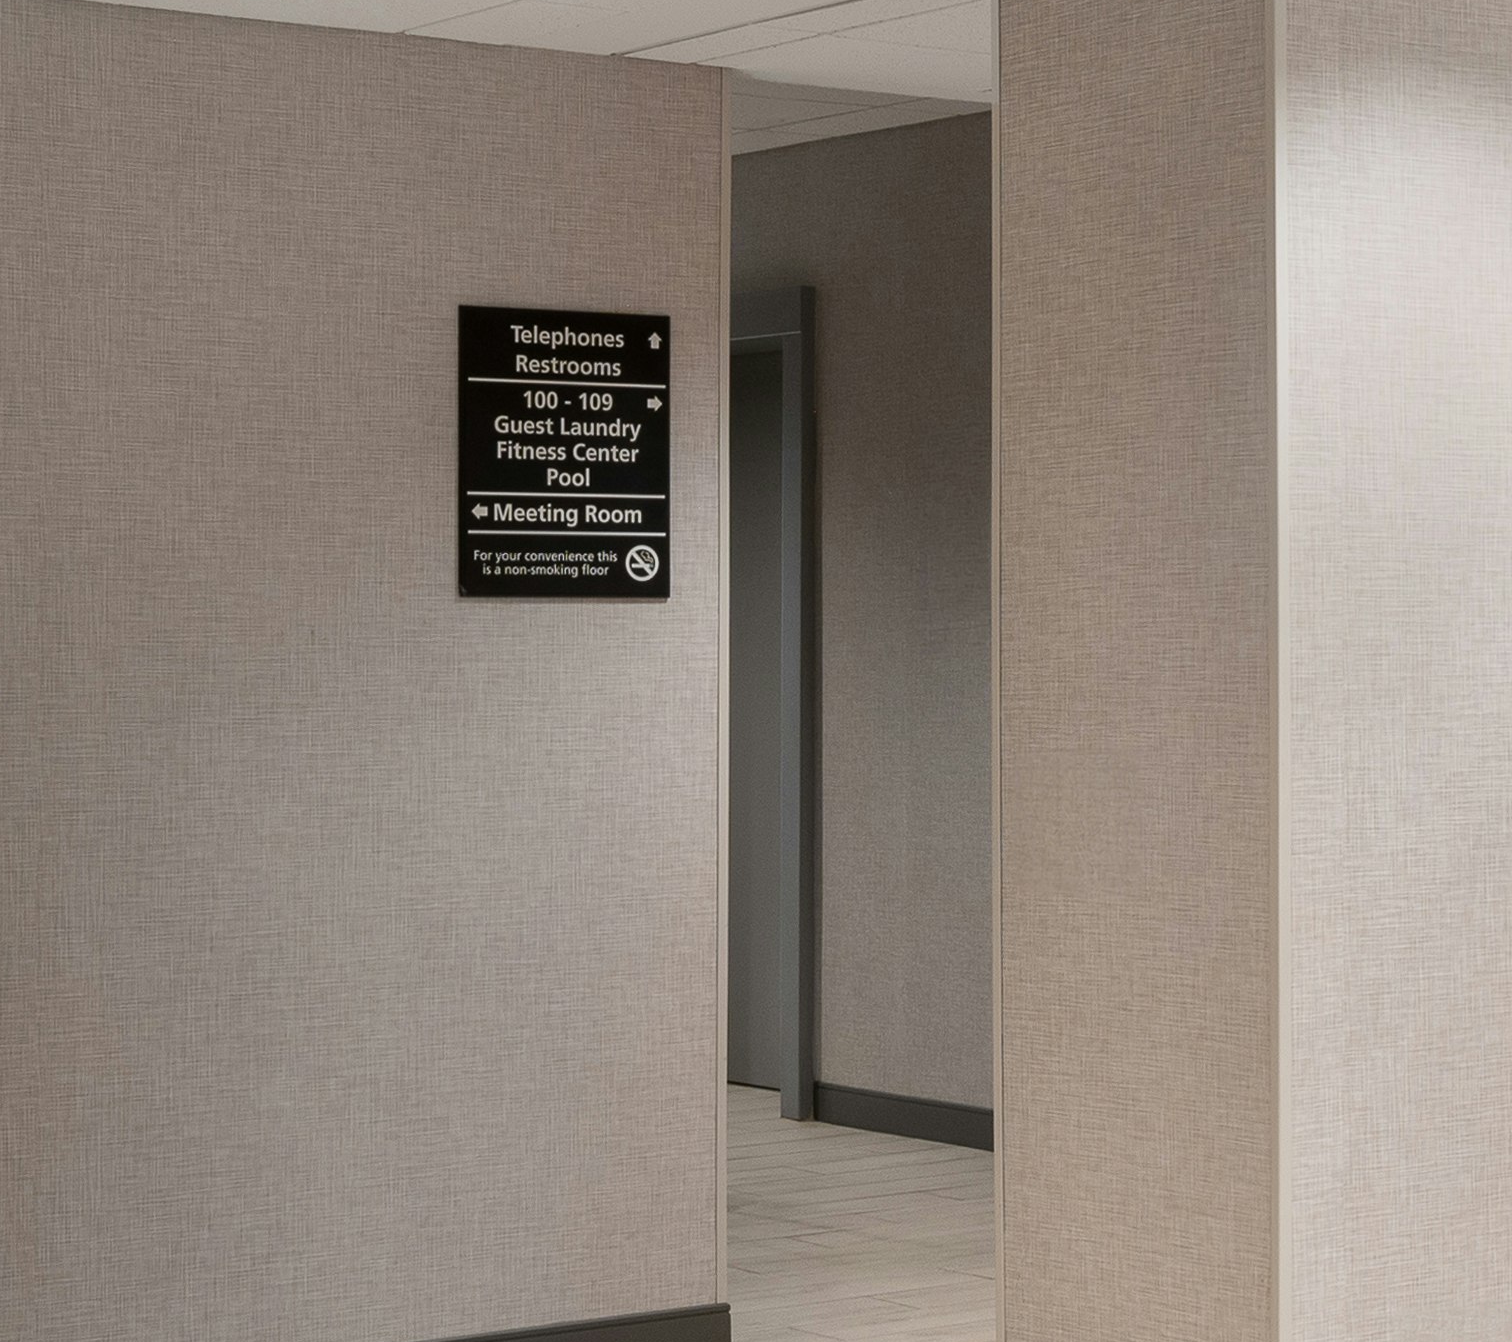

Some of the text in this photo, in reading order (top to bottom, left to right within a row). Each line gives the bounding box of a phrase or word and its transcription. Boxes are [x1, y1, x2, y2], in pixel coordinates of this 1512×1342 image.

[510, 324, 625, 349] Telephones
[515, 354, 622, 377] Restrooms
[523, 390, 558, 409] 100
[578, 392, 613, 411] 109
[494, 415, 641, 442] Guest Laundry
[497, 440, 639, 462] Fitness Center
[546, 467, 590, 487] Pool
[493, 503, 642, 527] Meeting Room
[473, 549, 618, 563] For your convenience this
[482, 564, 610, 578] is a non-smoking floor
